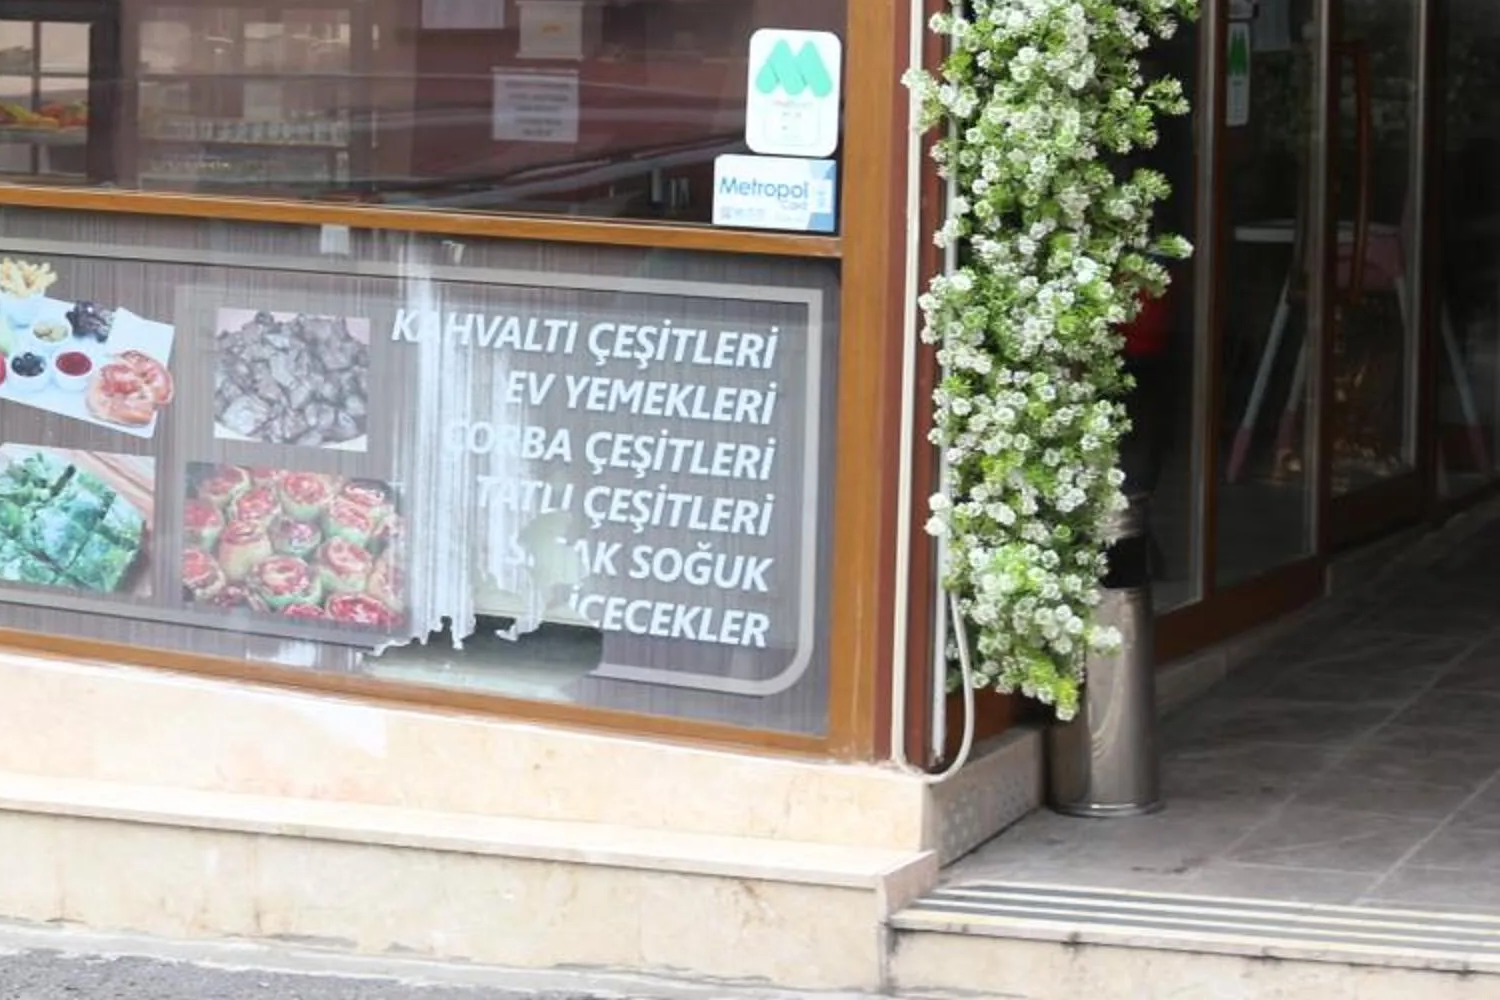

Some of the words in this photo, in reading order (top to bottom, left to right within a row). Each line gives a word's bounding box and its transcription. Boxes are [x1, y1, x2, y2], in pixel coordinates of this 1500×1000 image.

[719, 176, 809, 201] Metropol
[588, 318, 780, 370] ÇEŞİTLERİ
[504, 369, 556, 407] EV
[564, 374, 779, 426] YEMEKLERİ
[585, 428, 777, 481] ÇEŞİTLERİ
[583, 483, 775, 537] ÇEŞİTLERİ
[628, 542, 773, 593] SOĞUK
